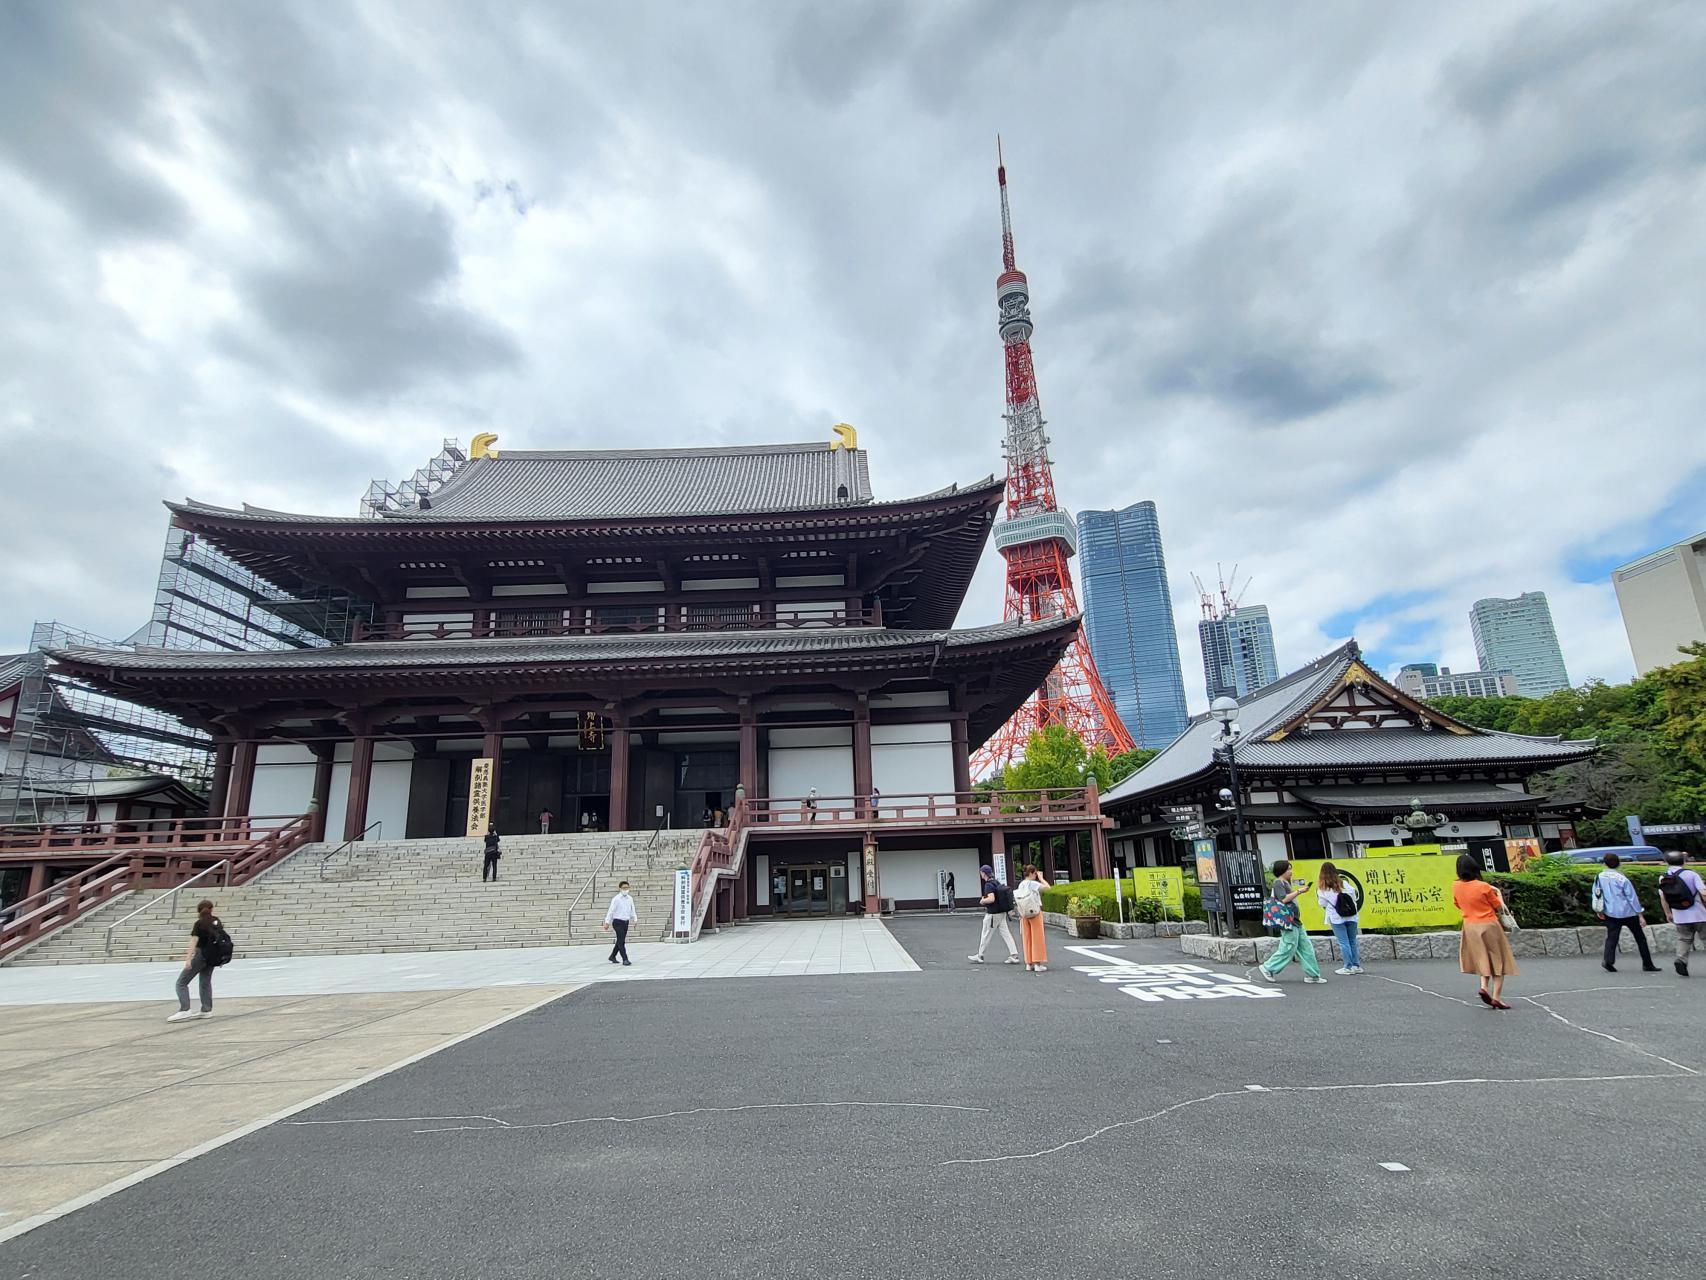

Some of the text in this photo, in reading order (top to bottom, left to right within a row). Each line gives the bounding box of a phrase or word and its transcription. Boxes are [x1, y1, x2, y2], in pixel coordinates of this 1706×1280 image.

[1365, 869, 1405, 885] 増上寺
[1368, 886, 1444, 904] 宝物展示室
[1422, 905, 1445, 913] Gallery
